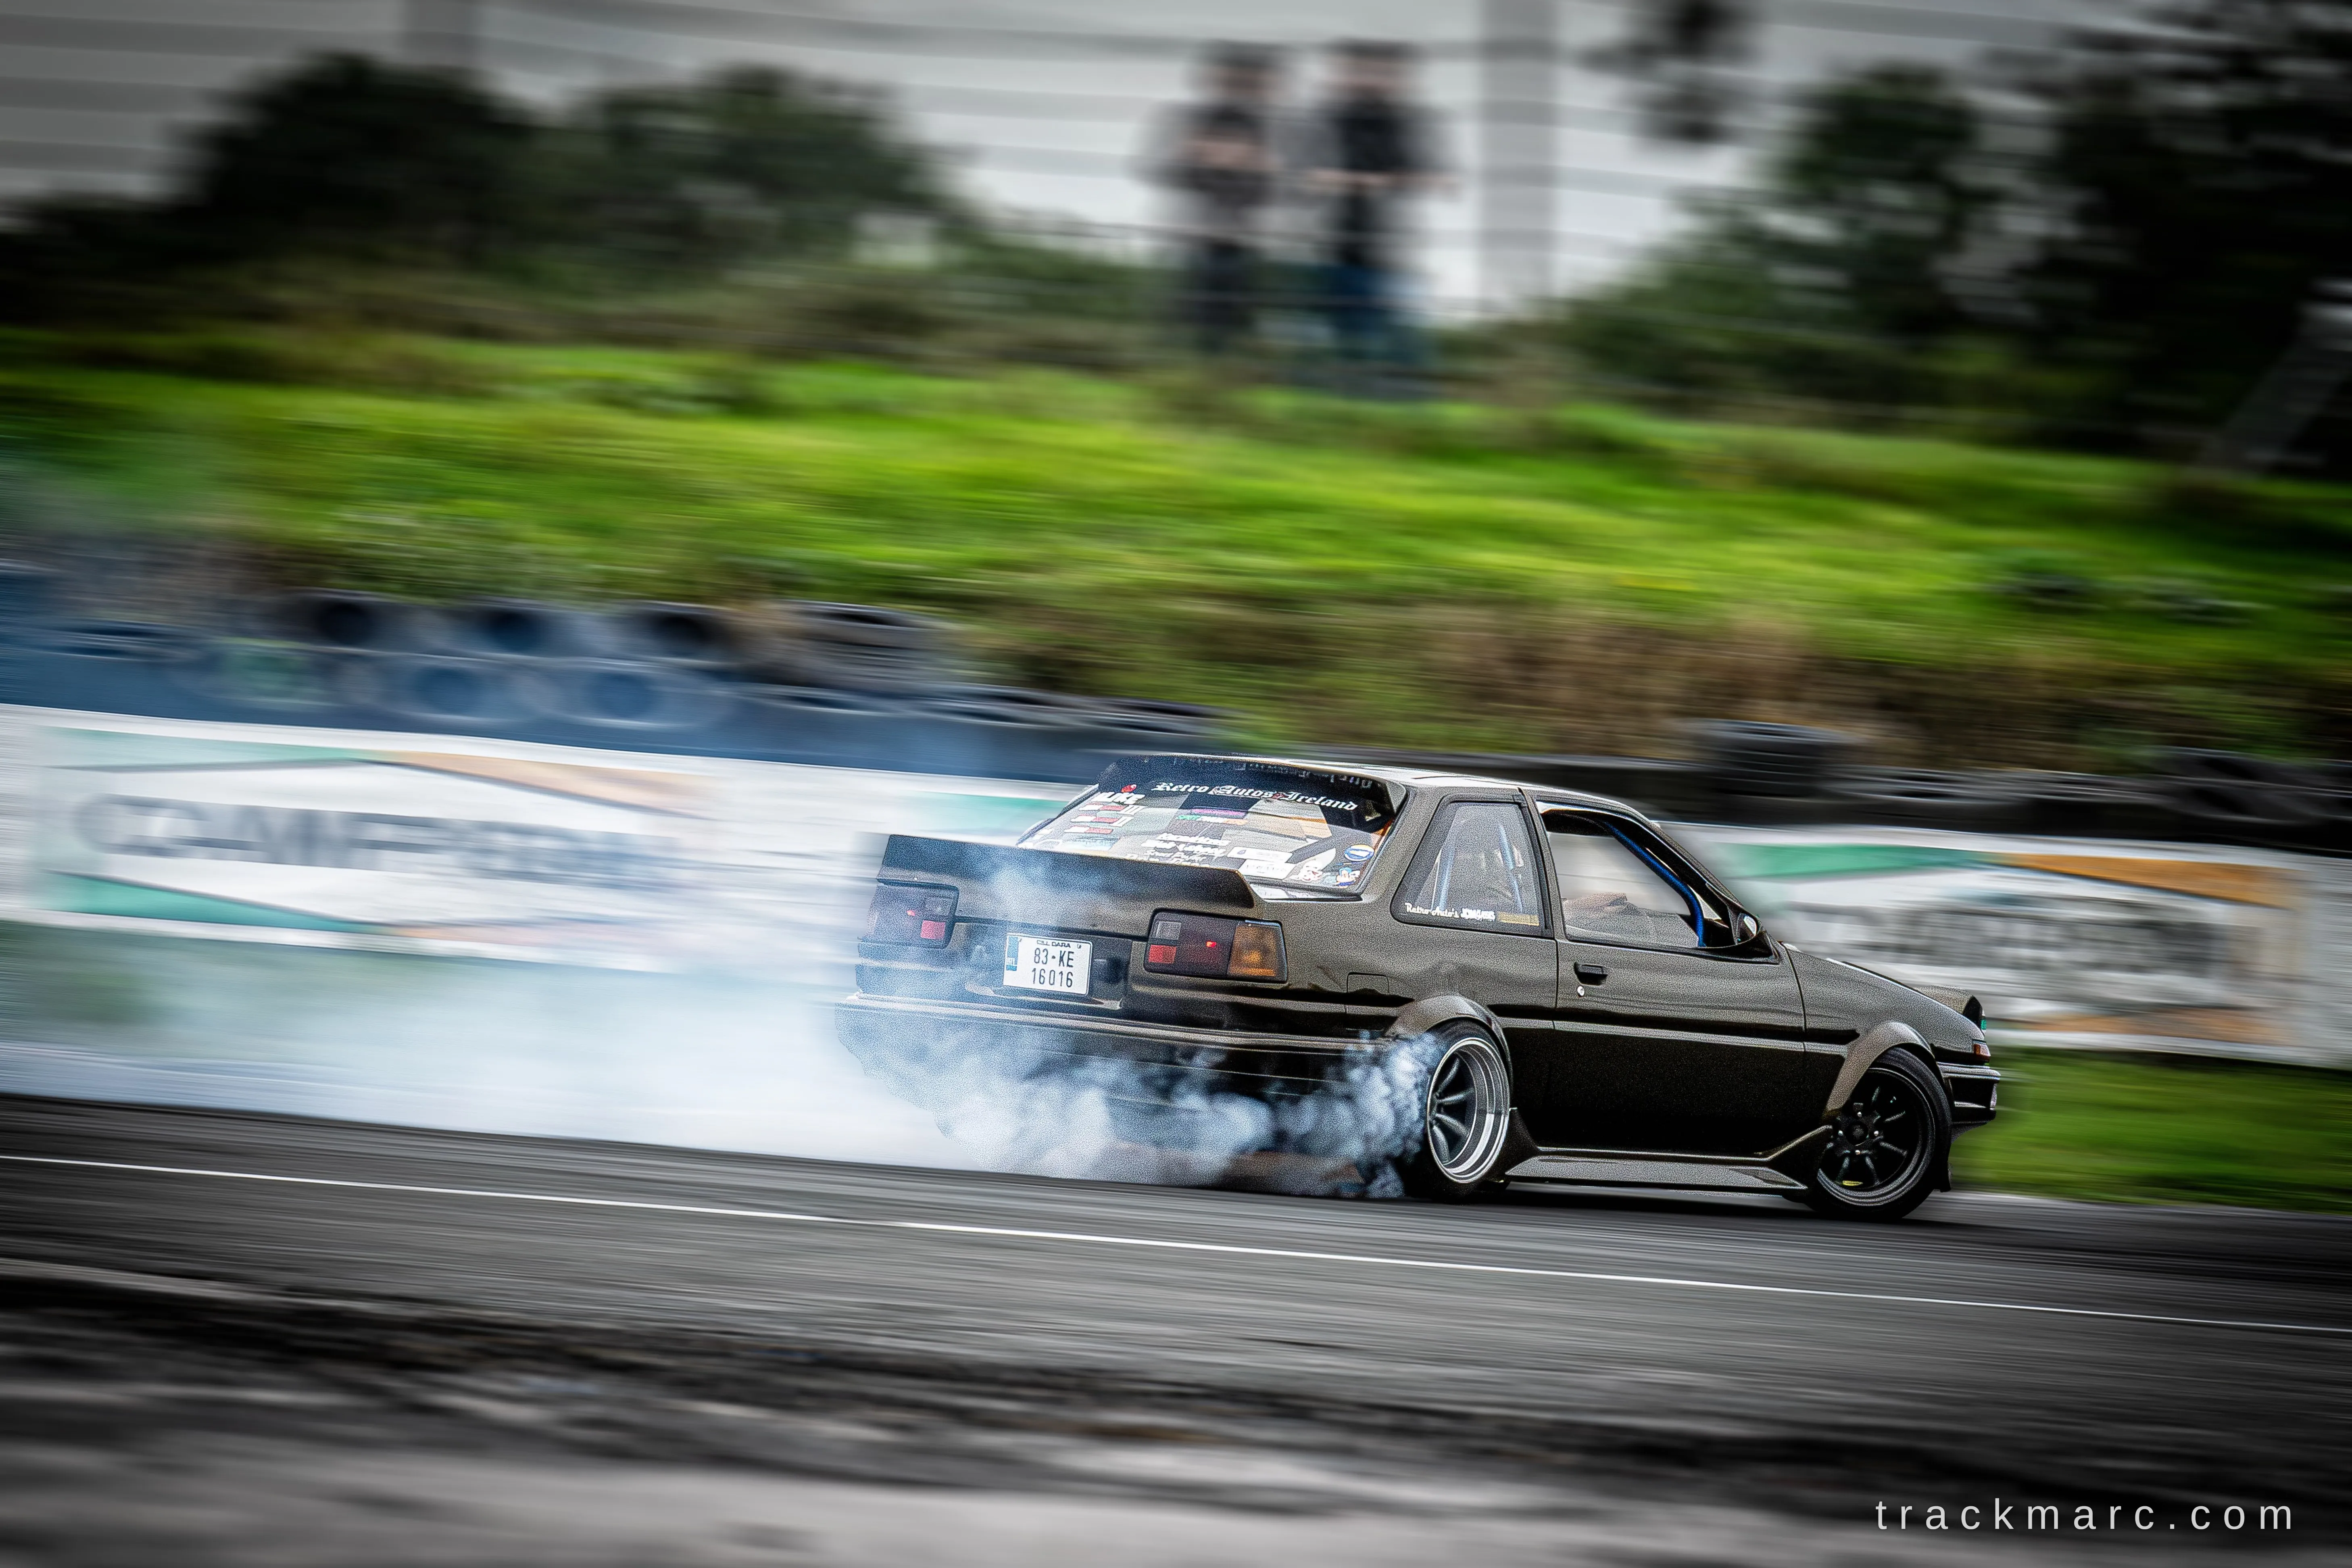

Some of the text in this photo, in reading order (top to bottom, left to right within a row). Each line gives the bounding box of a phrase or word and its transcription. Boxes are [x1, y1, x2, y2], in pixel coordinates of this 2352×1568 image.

[1151, 782, 1358, 811] Retro Autos Ireland
[1032, 968, 1074, 988] 16016
